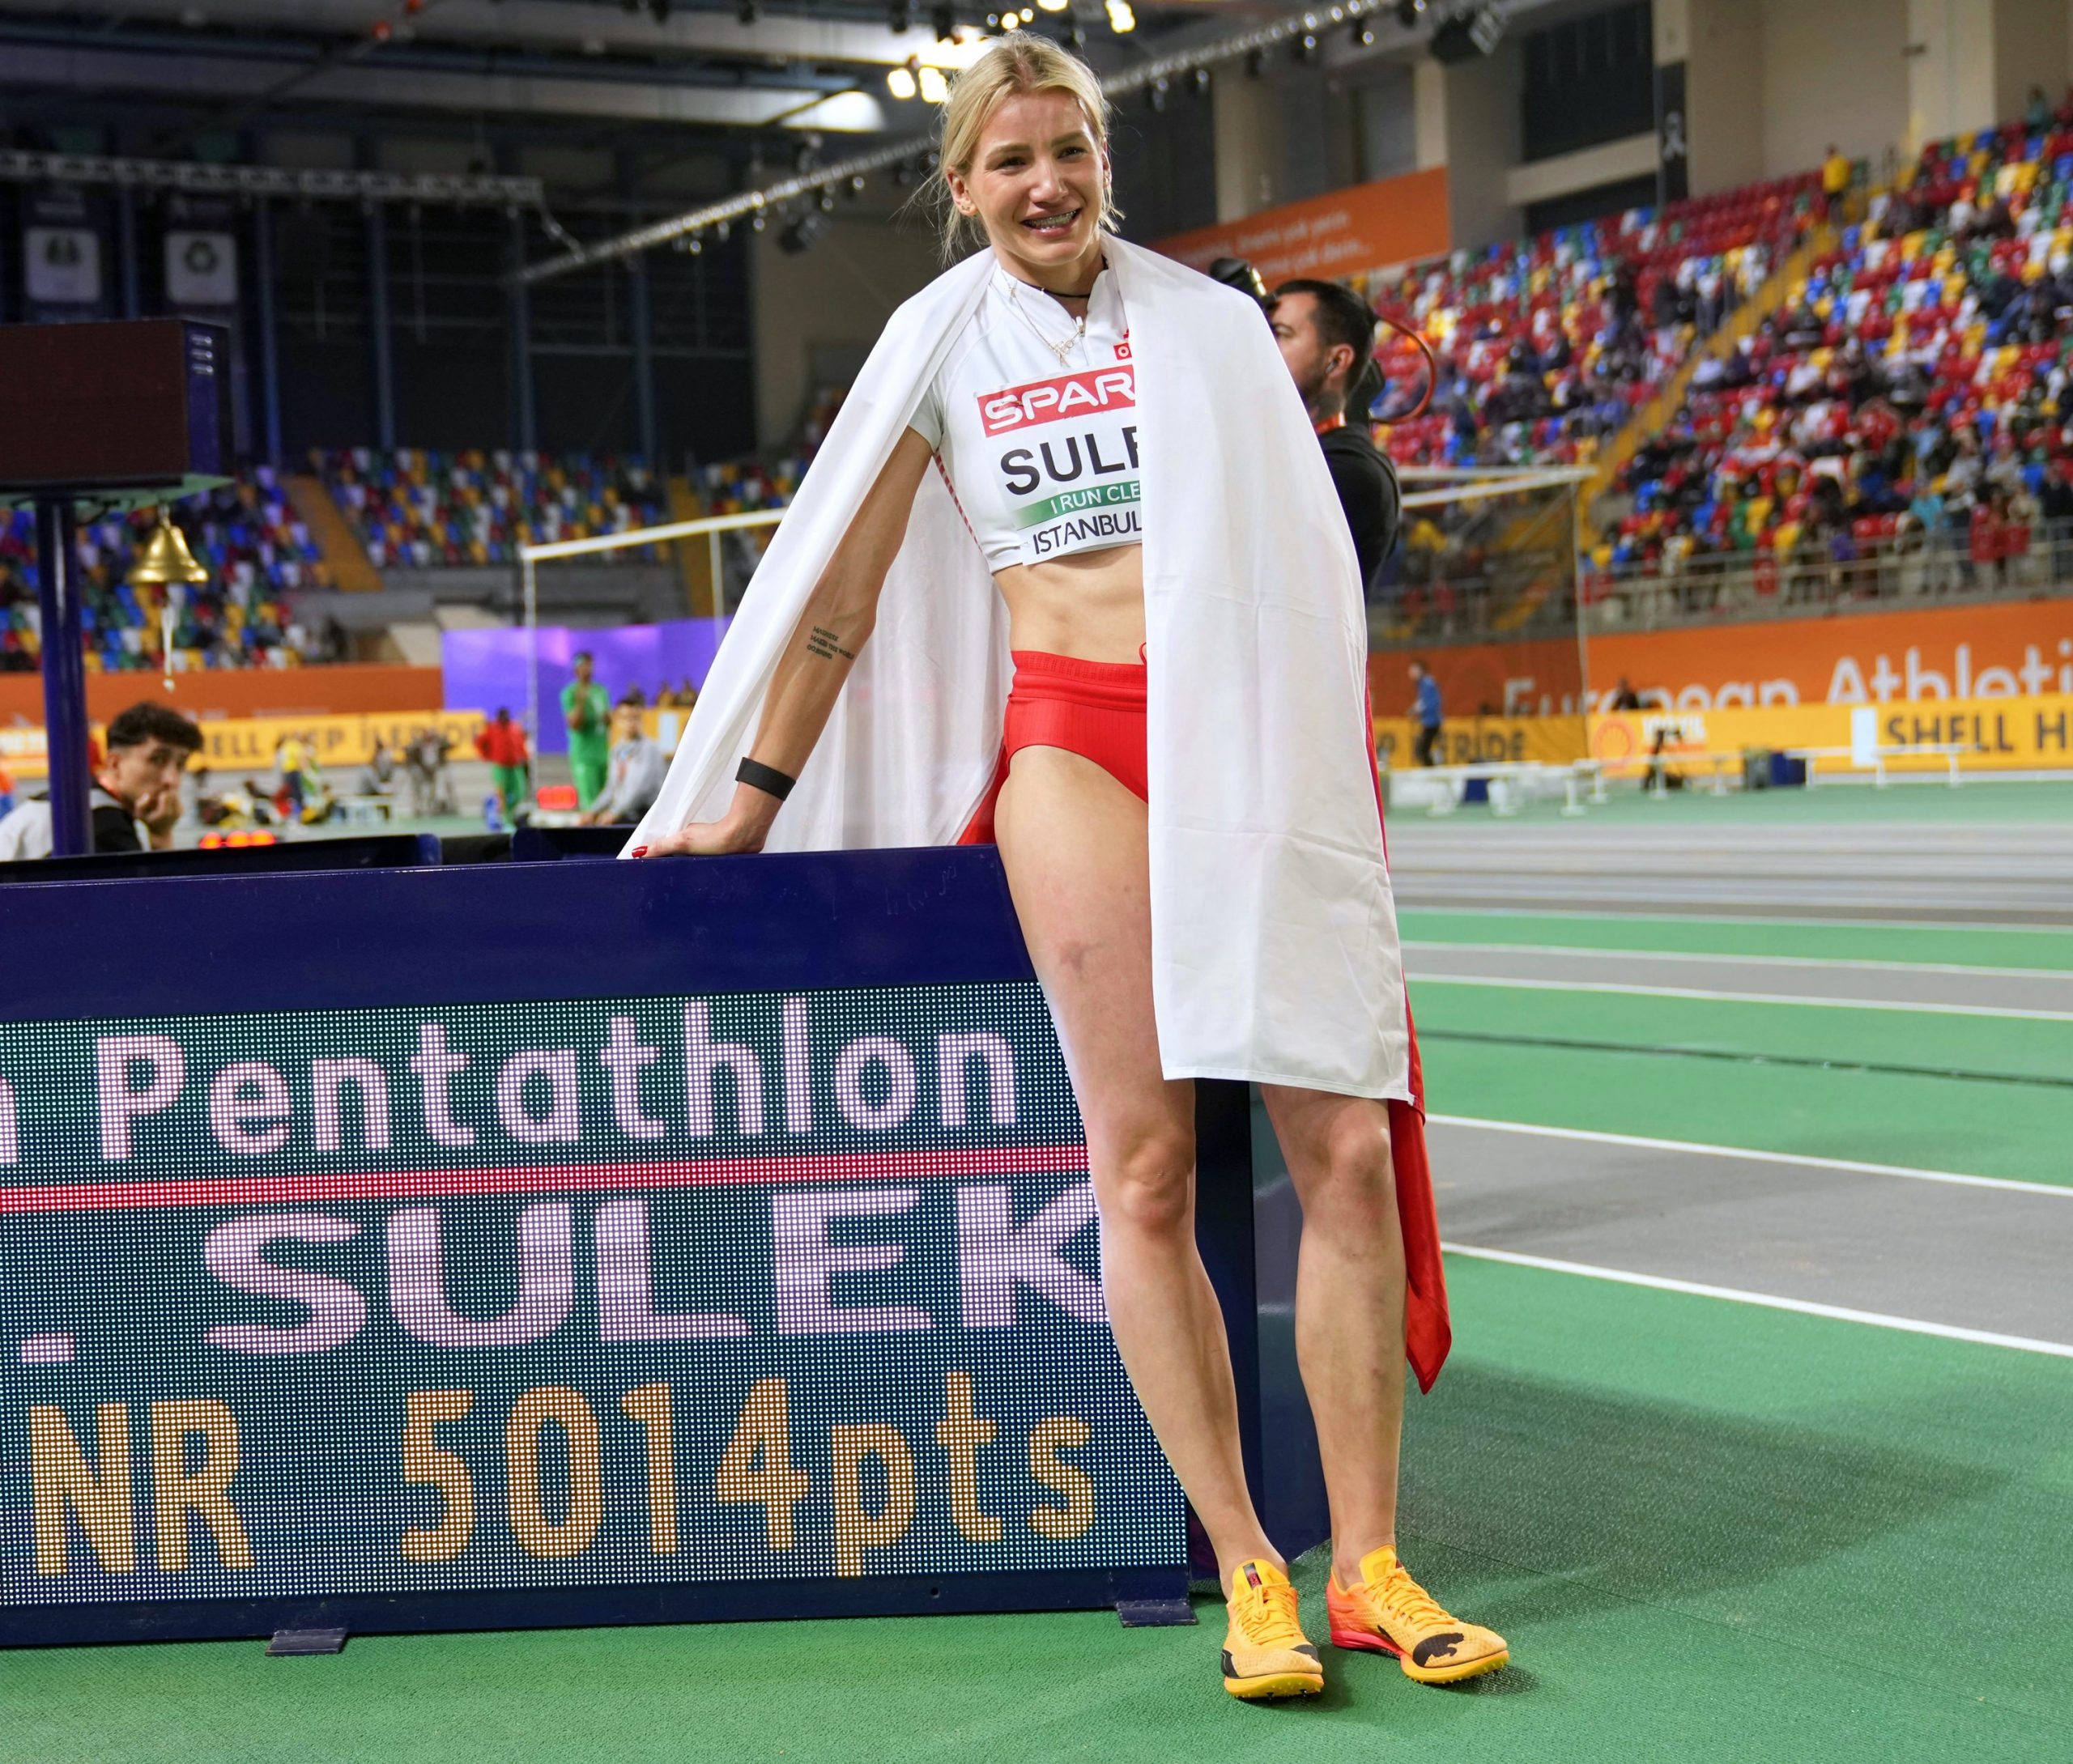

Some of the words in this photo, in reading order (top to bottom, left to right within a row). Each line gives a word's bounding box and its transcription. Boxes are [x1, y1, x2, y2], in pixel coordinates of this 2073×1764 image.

[984, 371, 1135, 431] SPAR
[1049, 499, 1058, 515] I
[1061, 488, 1102, 508] RUN
[1032, 510, 1142, 555] ISTANBUL
[1885, 711, 2016, 752] SHELL
[96, 997, 1017, 1160] Pentathlon
[204, 1182, 1110, 1355] SULEK
[29, 1398, 256, 1576] NR
[400, 1370, 1096, 1579] 5014pts
